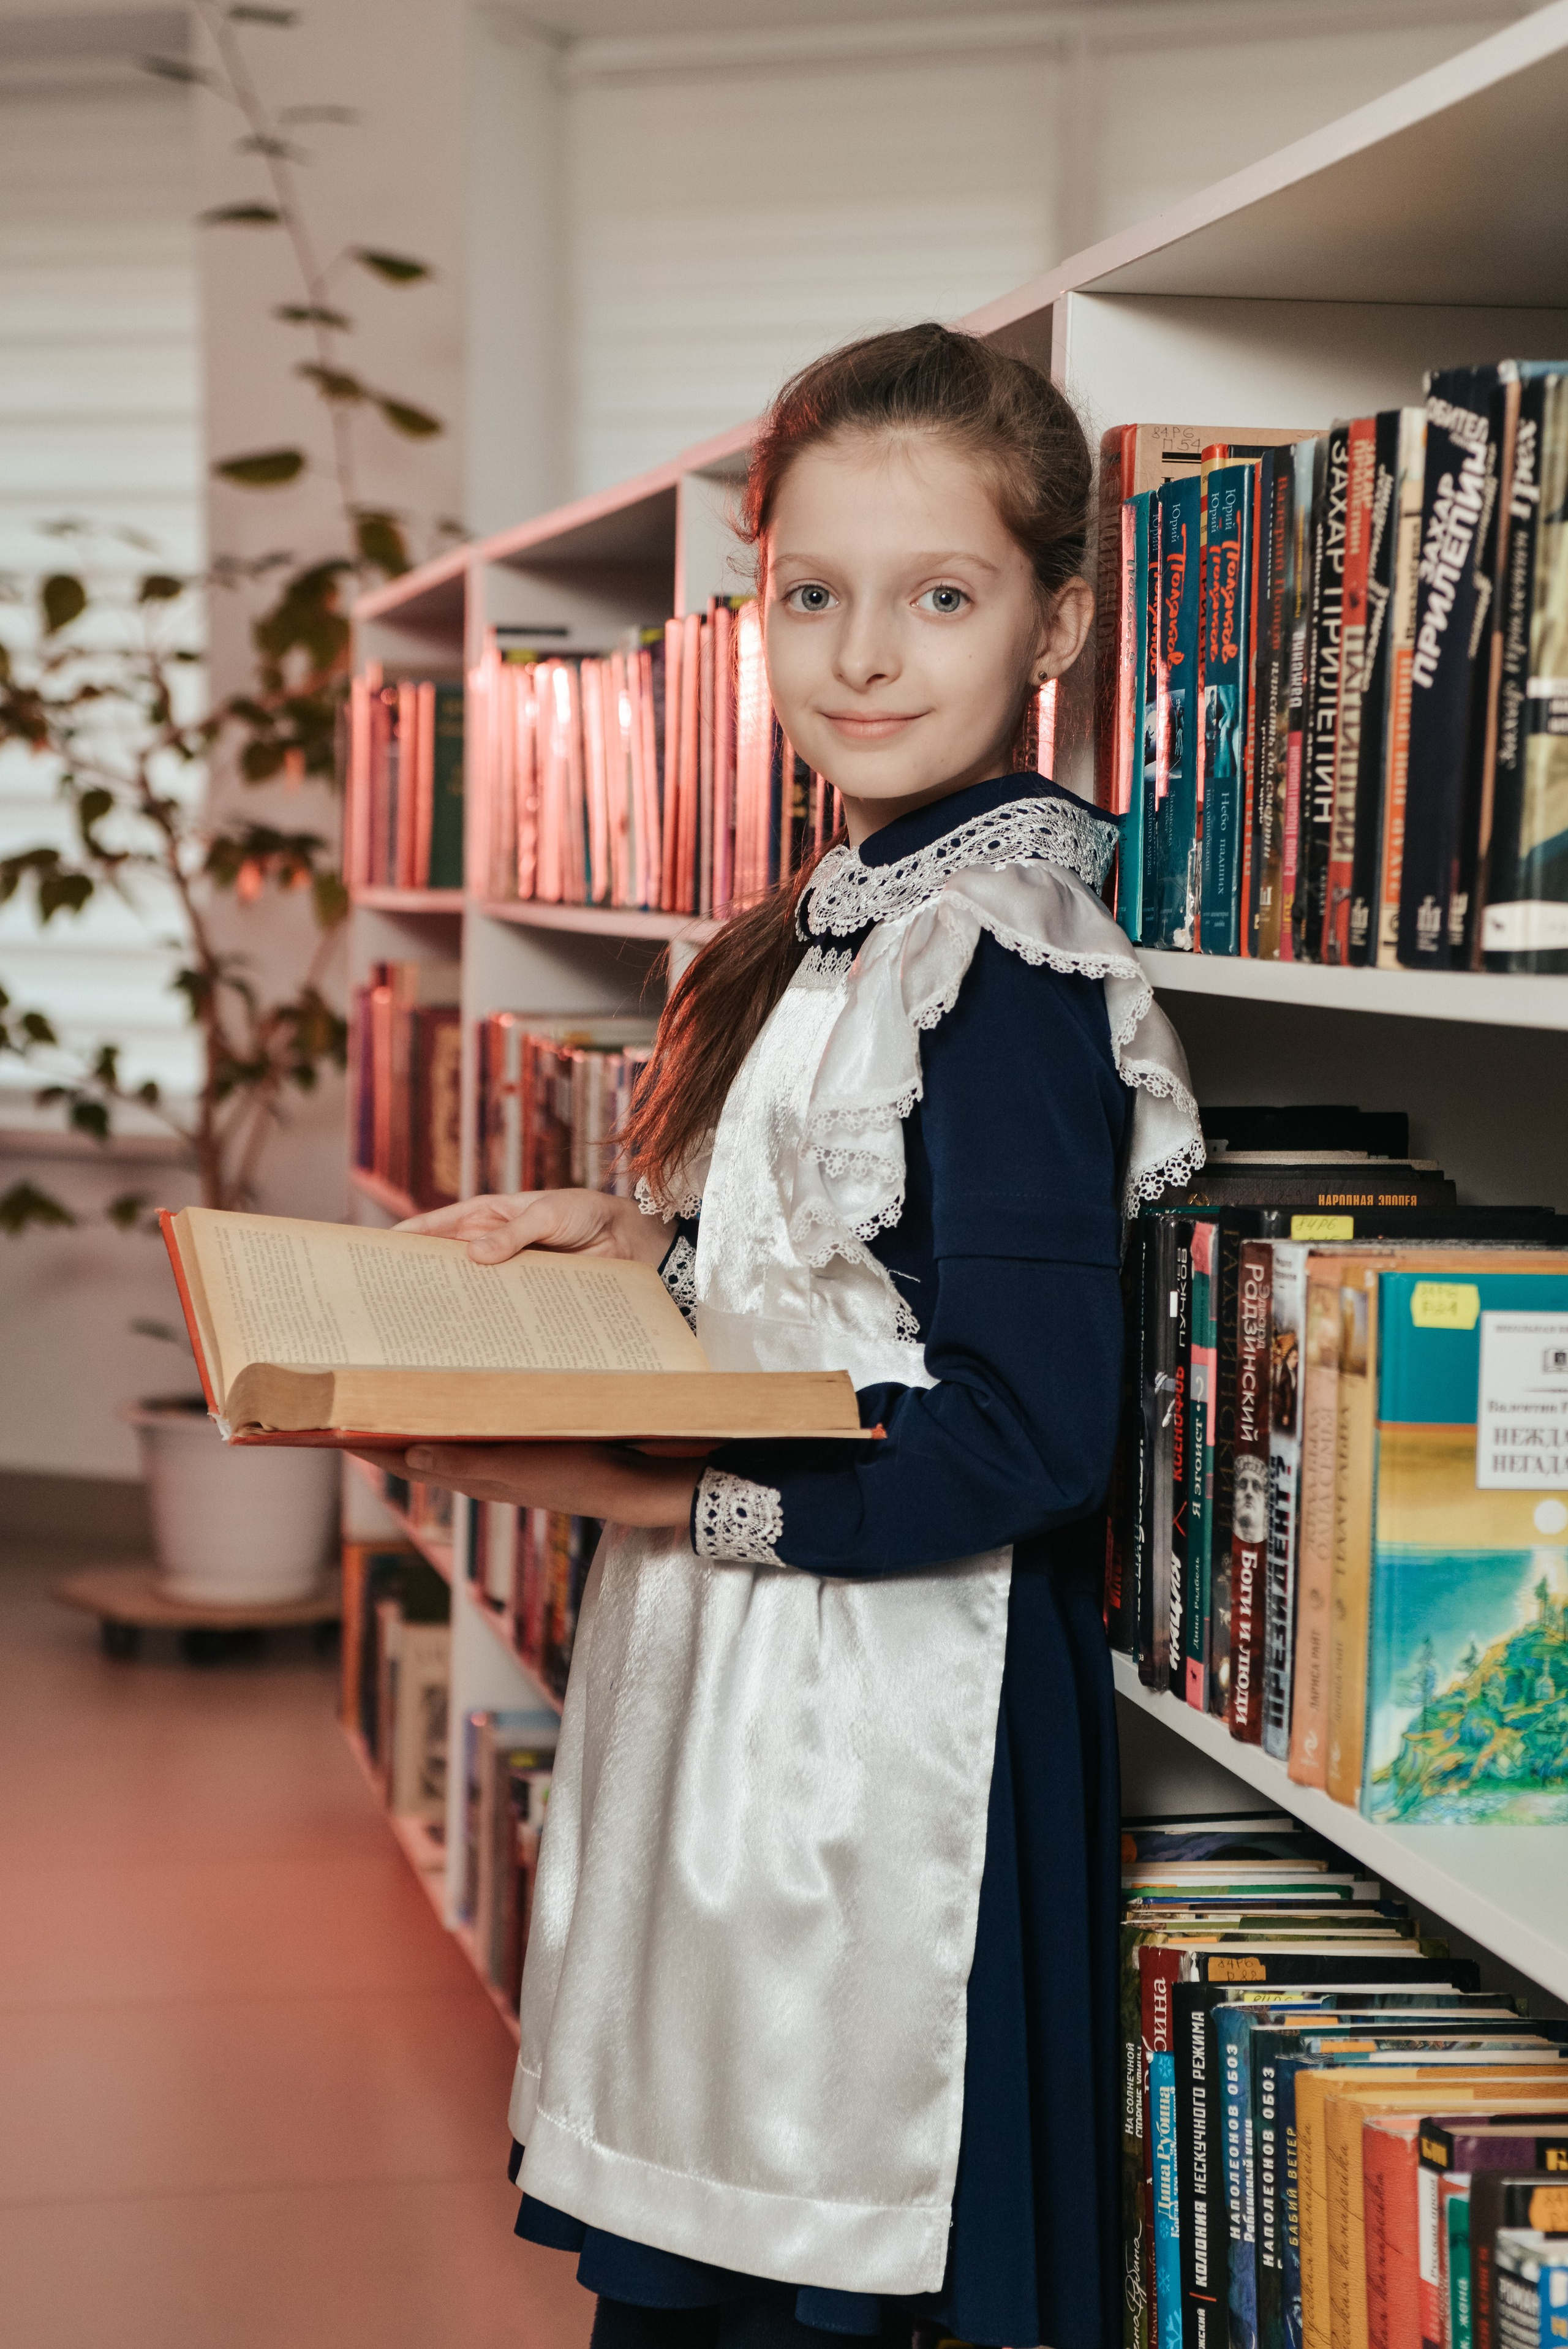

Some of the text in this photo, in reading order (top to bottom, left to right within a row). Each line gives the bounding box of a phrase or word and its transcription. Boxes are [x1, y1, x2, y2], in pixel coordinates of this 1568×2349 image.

[1324, 439, 1349, 574] ЗАХАР
[1411, 442, 1488, 688] ПРИЛЕПИН
[1418, 472, 1453, 580] ЗАХАР
[1166, 502, 1187, 671] Юрий Поляков
[1208, 492, 1221, 662] Юрий Поляков
[1219, 489, 1242, 665] Юрий Поляков
[1313, 587, 1345, 822] ПРИЛЕПИН
[1205, 812, 1216, 871] ошибками
[1218, 792, 1230, 895] Небо падших
[1179, 1247, 1188, 1348] ПУЧКОВ
[1256, 1286, 1270, 1349] Эдвард
[1192, 1501, 1202, 1519] Я
[1234, 1262, 1265, 1726] Радзинский Боги и люди
[1125, 2043, 1136, 2135] НА СОЛНЕЧНОЙ
[1191, 2011, 1205, 2080] РЕЖИМА
[1155, 2086, 1176, 2219] Дина Рубина
[1192, 2087, 1206, 2194] НЕСКУЧНОГО
[1226, 2044, 1241, 2240] НАПОЛЕОНОВ ОБОЗ
[1262, 2066, 1275, 2268] НАПОЛЕОНОВ ОБОЗ
[1286, 2127, 1299, 2247] БАБИЙ ВЕТЕР
[1194, 2201, 1207, 2287] КОЛОНИЯ
